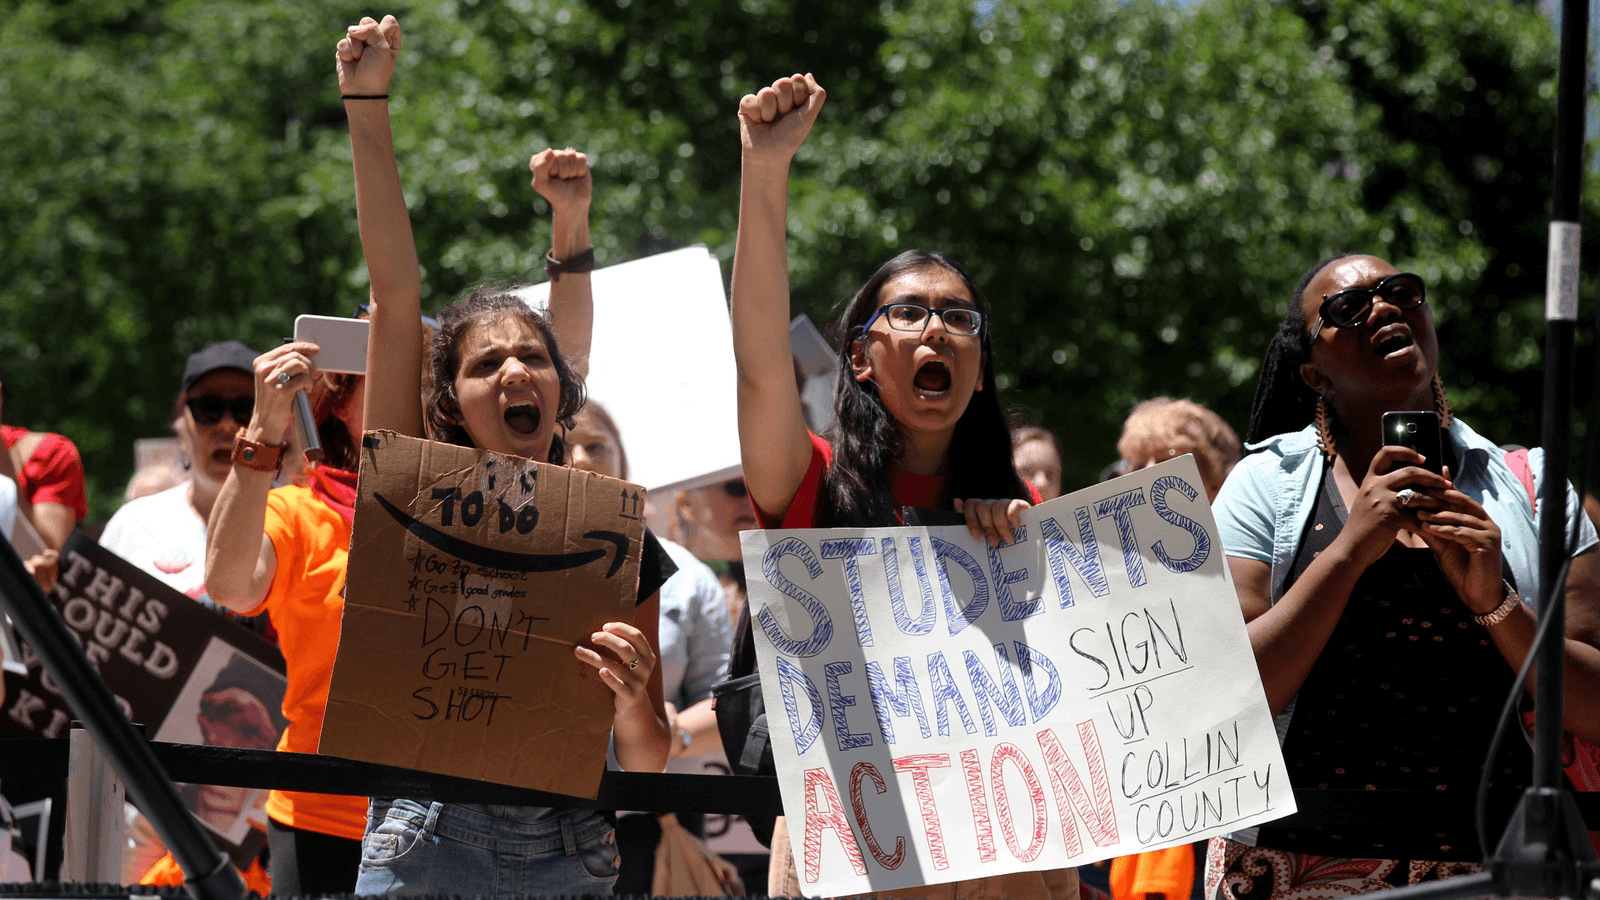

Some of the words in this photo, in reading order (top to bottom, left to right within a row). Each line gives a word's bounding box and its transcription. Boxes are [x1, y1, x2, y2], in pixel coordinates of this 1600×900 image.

[431, 487, 484, 527] TO
[497, 498, 539, 535] DO
[62, 551, 169, 633] THIS
[464, 583, 489, 600] good
[491, 585, 528, 600] grades
[757, 475, 1211, 657] STUDENTS
[421, 597, 549, 651] DON'T
[1068, 598, 1189, 691] SIGN
[423, 648, 514, 682] GET
[777, 641, 1062, 755] DEMAND
[412, 687, 512, 726] SHOT
[1107, 685, 1154, 740] UP
[1120, 720, 1241, 799] COLLIN
[802, 718, 1121, 883] ACTION
[1134, 763, 1272, 845] COUNTY
